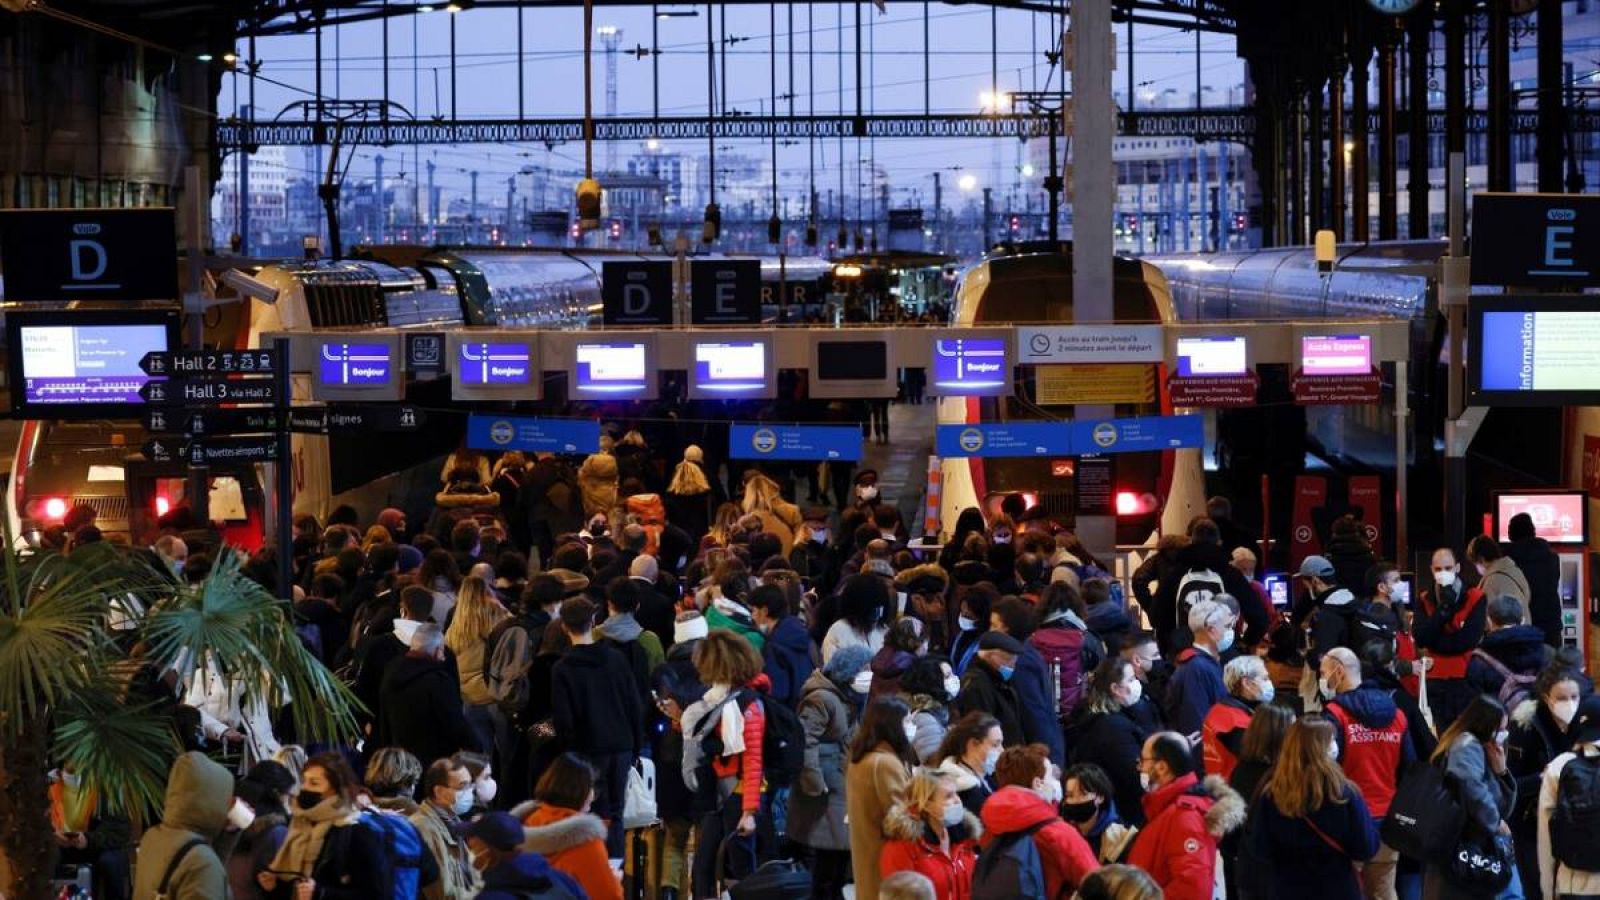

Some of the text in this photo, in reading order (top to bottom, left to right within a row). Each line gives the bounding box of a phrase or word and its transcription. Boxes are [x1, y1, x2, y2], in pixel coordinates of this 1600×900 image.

[1551, 210, 1572, 219] Voie
[1545, 226, 1575, 266] E
[69, 239, 108, 281] D
[623, 283, 651, 315] D
[715, 283, 737, 313] E
[793, 286, 806, 303] R
[1058, 335, 1079, 343] Accès
[1092, 335, 1110, 343] train
[1058, 344, 1063, 352] 2
[1064, 344, 1095, 352] minutes
[1127, 344, 1152, 353] départ
[1519, 312, 1533, 390] Information
[174, 356, 255, 371] Hall 2 5 23
[967, 362, 1000, 373] Bonjour
[352, 367, 385, 378] Bonjour
[491, 366, 524, 377] Bonjour
[184, 384, 273, 399] Hall 3 via Hall 2
[331, 413, 362, 426] signes
[1350, 731, 1401, 744] ASSISTANC
